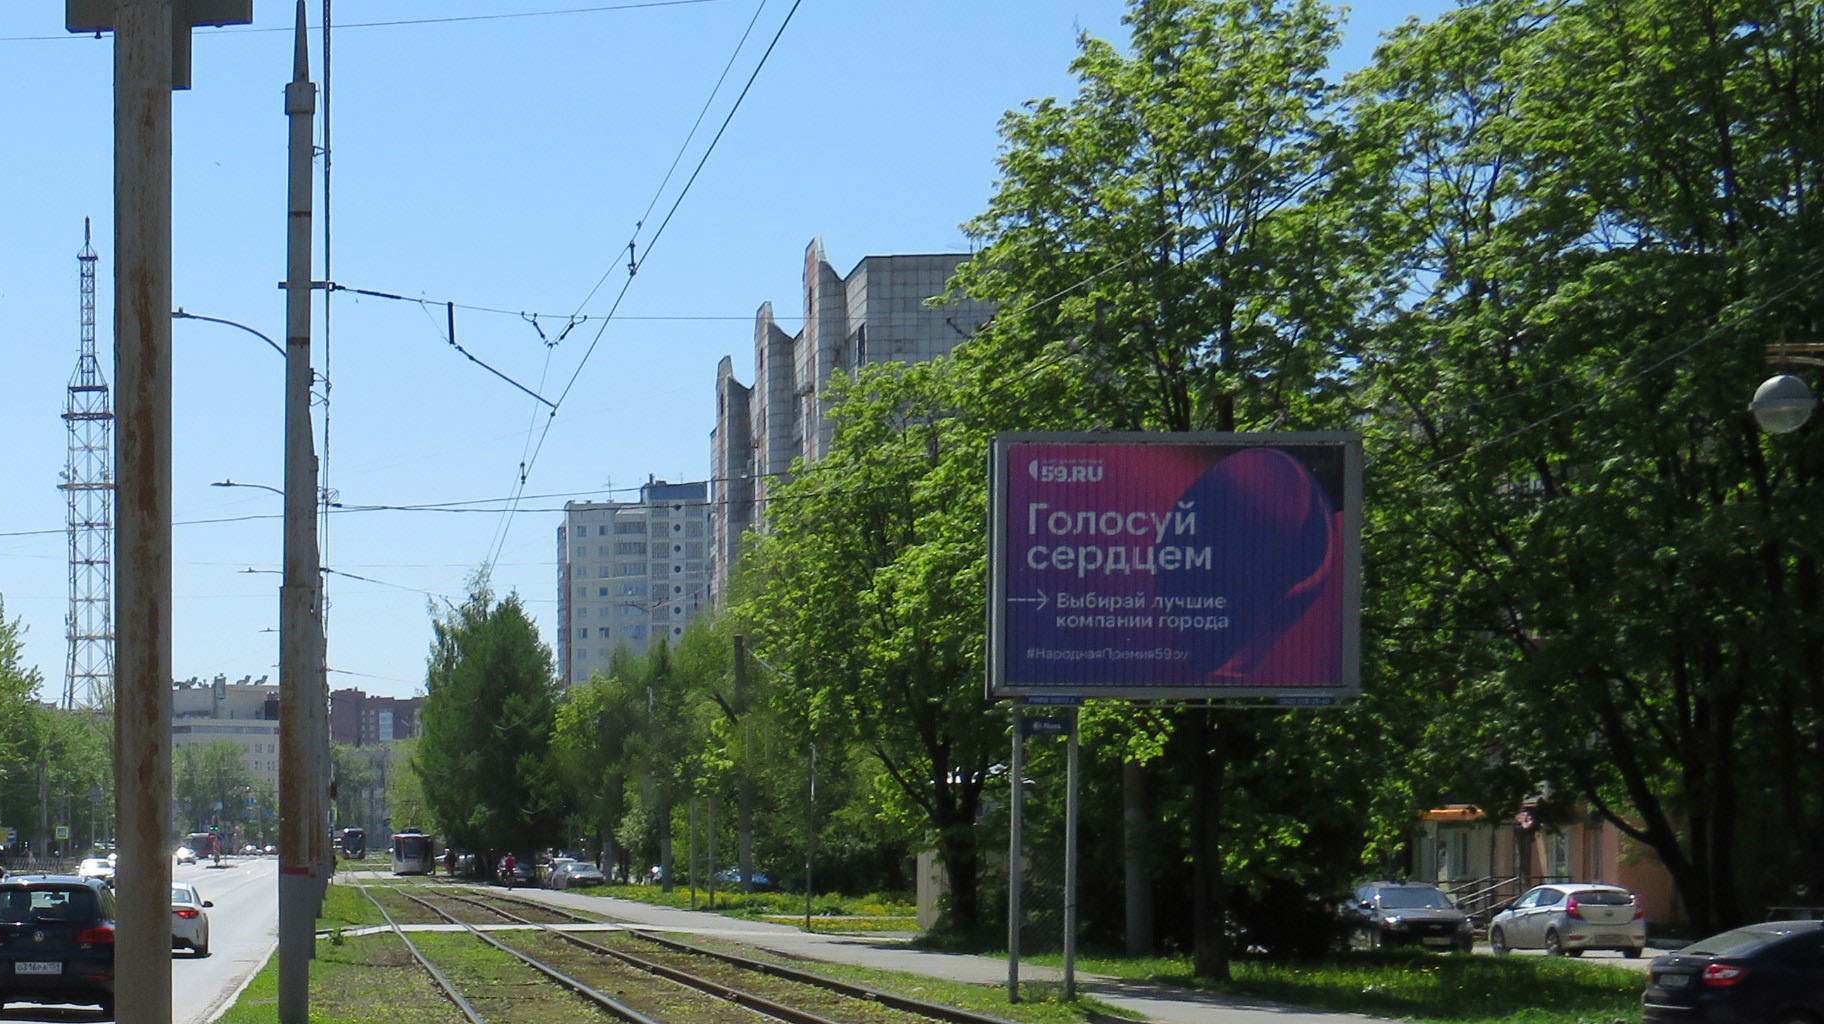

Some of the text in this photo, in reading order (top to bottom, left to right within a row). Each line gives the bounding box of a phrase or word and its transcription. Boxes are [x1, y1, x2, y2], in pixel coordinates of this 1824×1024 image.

[1040, 465, 1104, 482] 59.RU
[1028, 501, 1196, 543] Голосуй
[1027, 546, 1211, 577] сердцем
[1056, 593, 1226, 611] Выбирай лучшие
[1056, 614, 1229, 630] компании города
